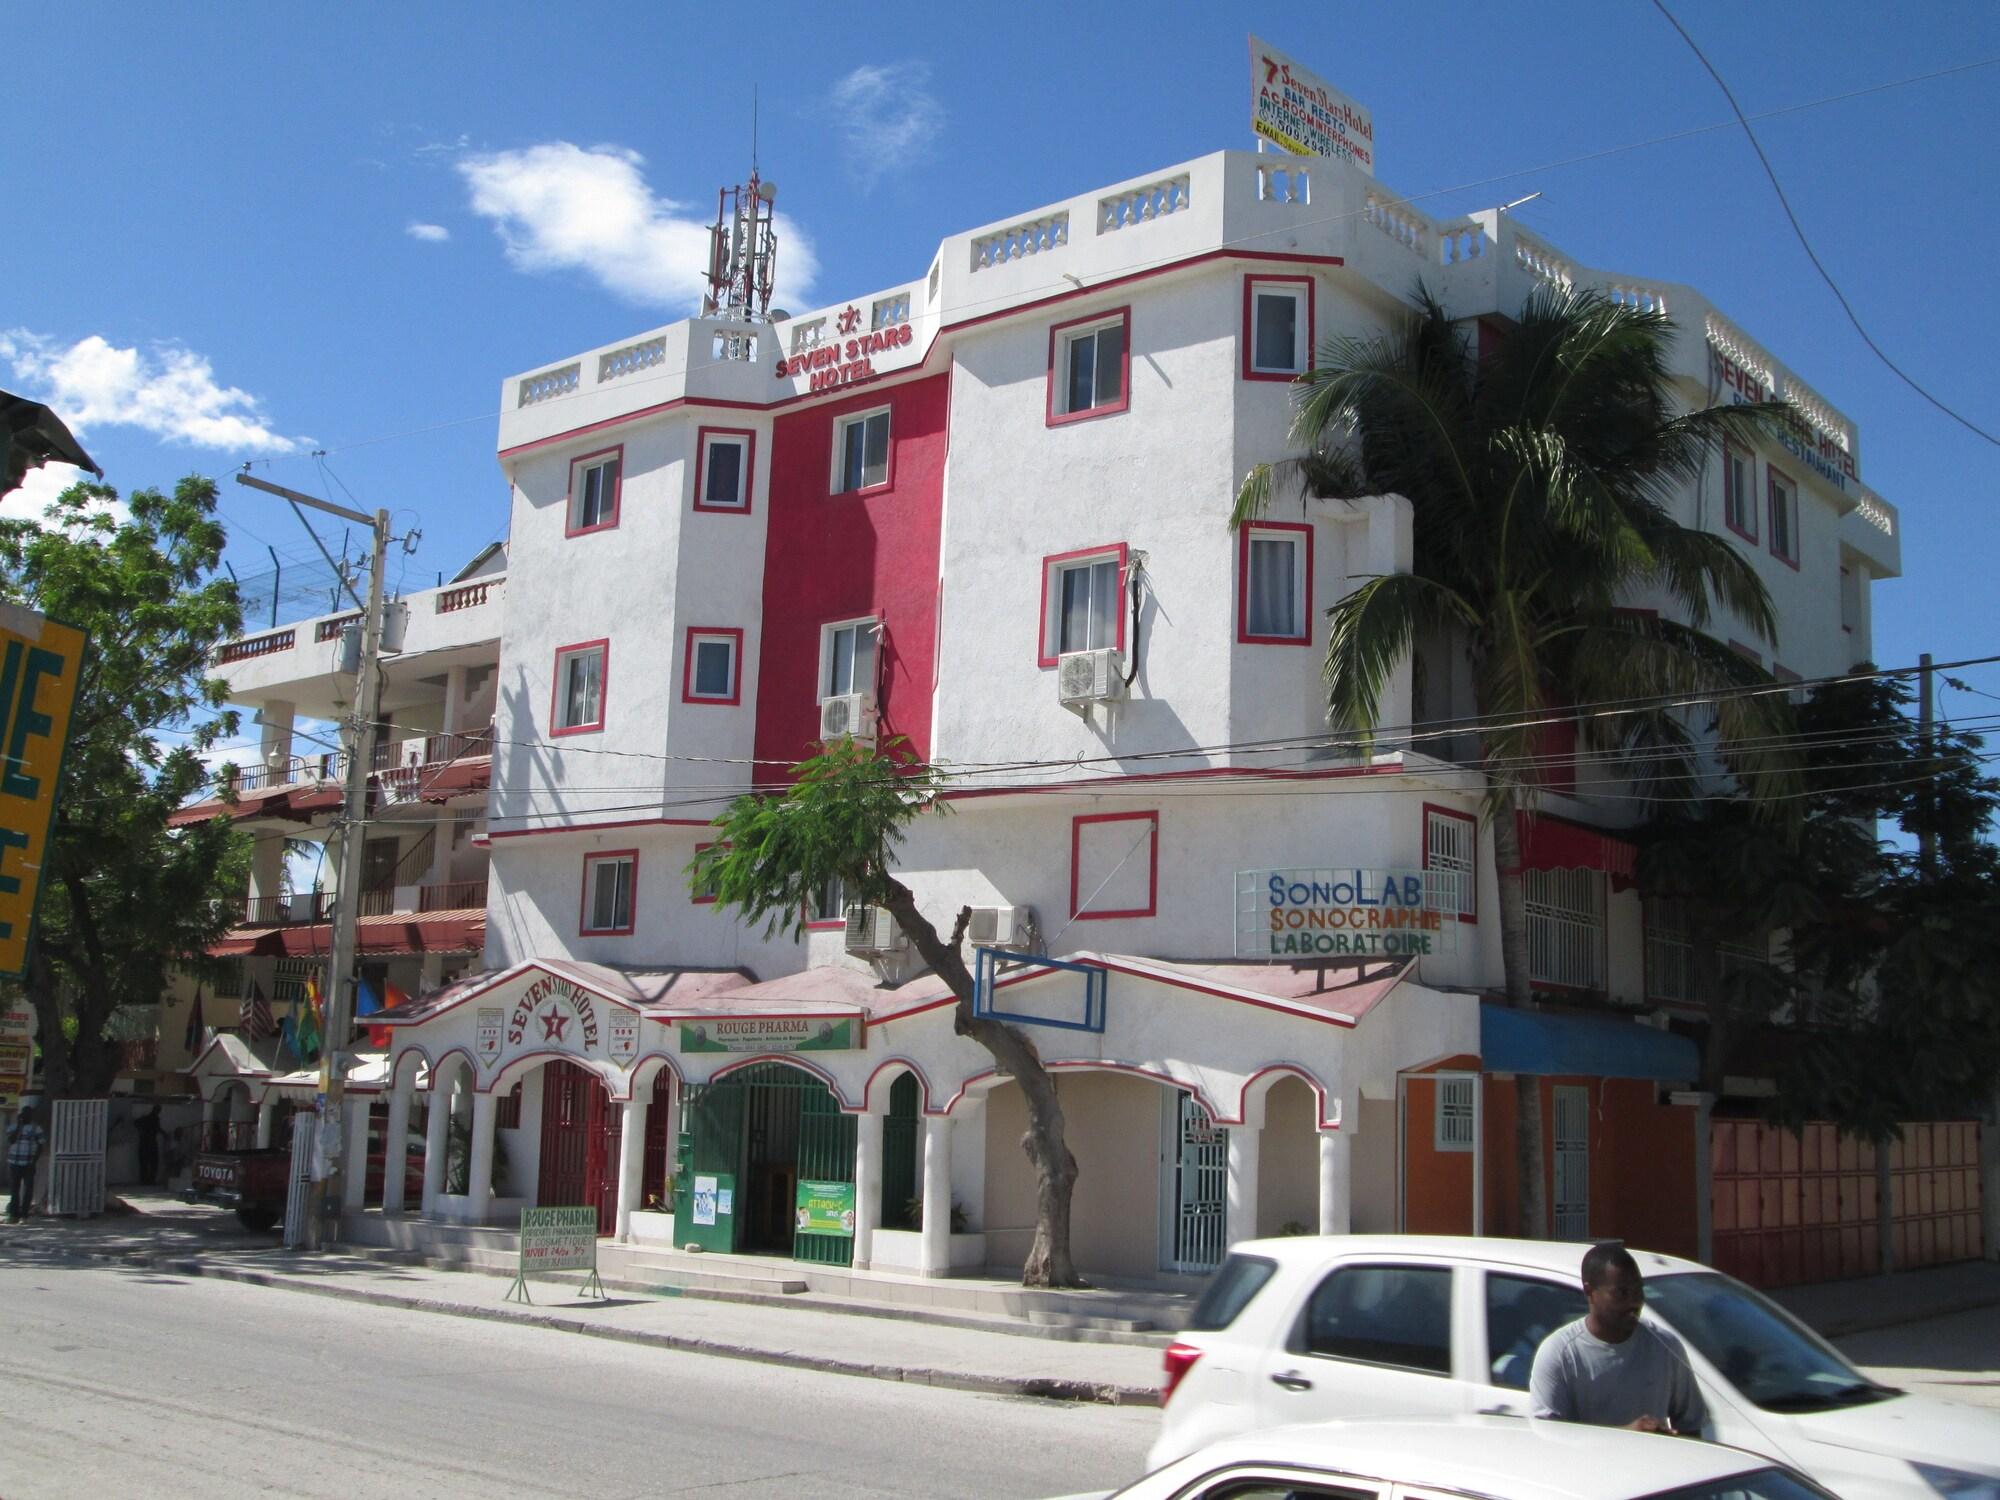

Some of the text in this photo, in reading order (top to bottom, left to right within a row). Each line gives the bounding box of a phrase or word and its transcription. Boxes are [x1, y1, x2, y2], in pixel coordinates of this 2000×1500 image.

[1262, 56, 1278, 84] 7
[1281, 64, 1316, 103] Seven
[1343, 103, 1373, 141] Hotel
[1282, 98, 1314, 126] ROOM
[1284, 87, 1346, 135] BAR RESTO
[1260, 96, 1306, 133] INTERNET
[776, 323, 913, 379] SEVEN STARS
[809, 357, 875, 391] HOTEL
[1269, 907, 1441, 932] SONOGRAPHIE
[1270, 932, 1432, 955] LABORATOIRE
[508, 976, 551, 1045] SEVEN
[570, 987, 599, 1052] HOTEL
[716, 1020, 809, 1034] ROUGE PHARMA
[200, 1165, 233, 1181] TOYOTA
[525, 1208, 594, 1228] ROUGE PHARMA
